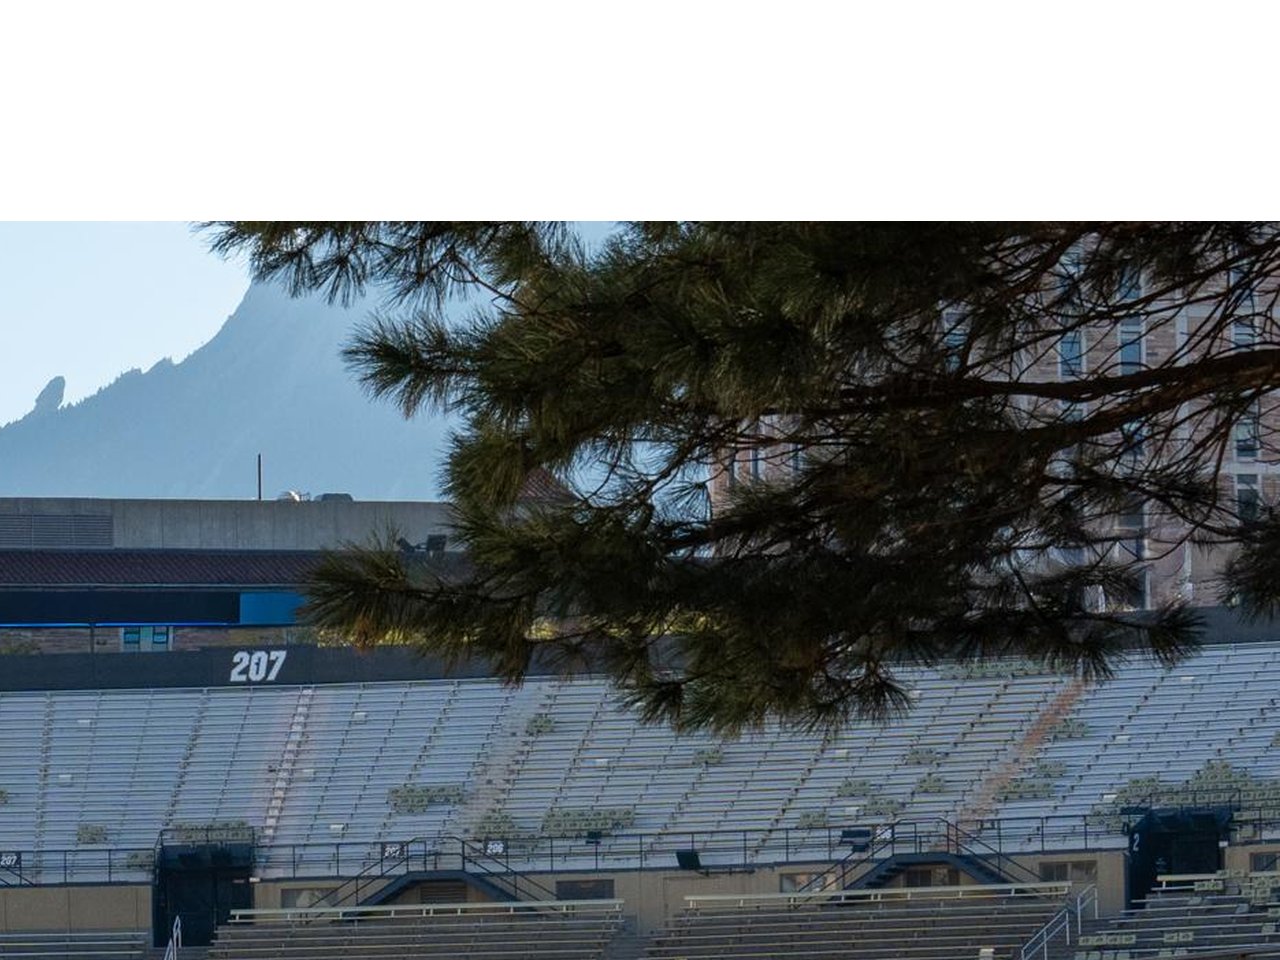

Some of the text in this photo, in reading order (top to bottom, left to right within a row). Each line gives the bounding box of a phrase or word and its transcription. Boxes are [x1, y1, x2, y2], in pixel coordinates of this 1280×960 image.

[230, 650, 287, 682] 207
[1133, 833, 1140, 851] 2
[0, 855, 17, 865] 207
